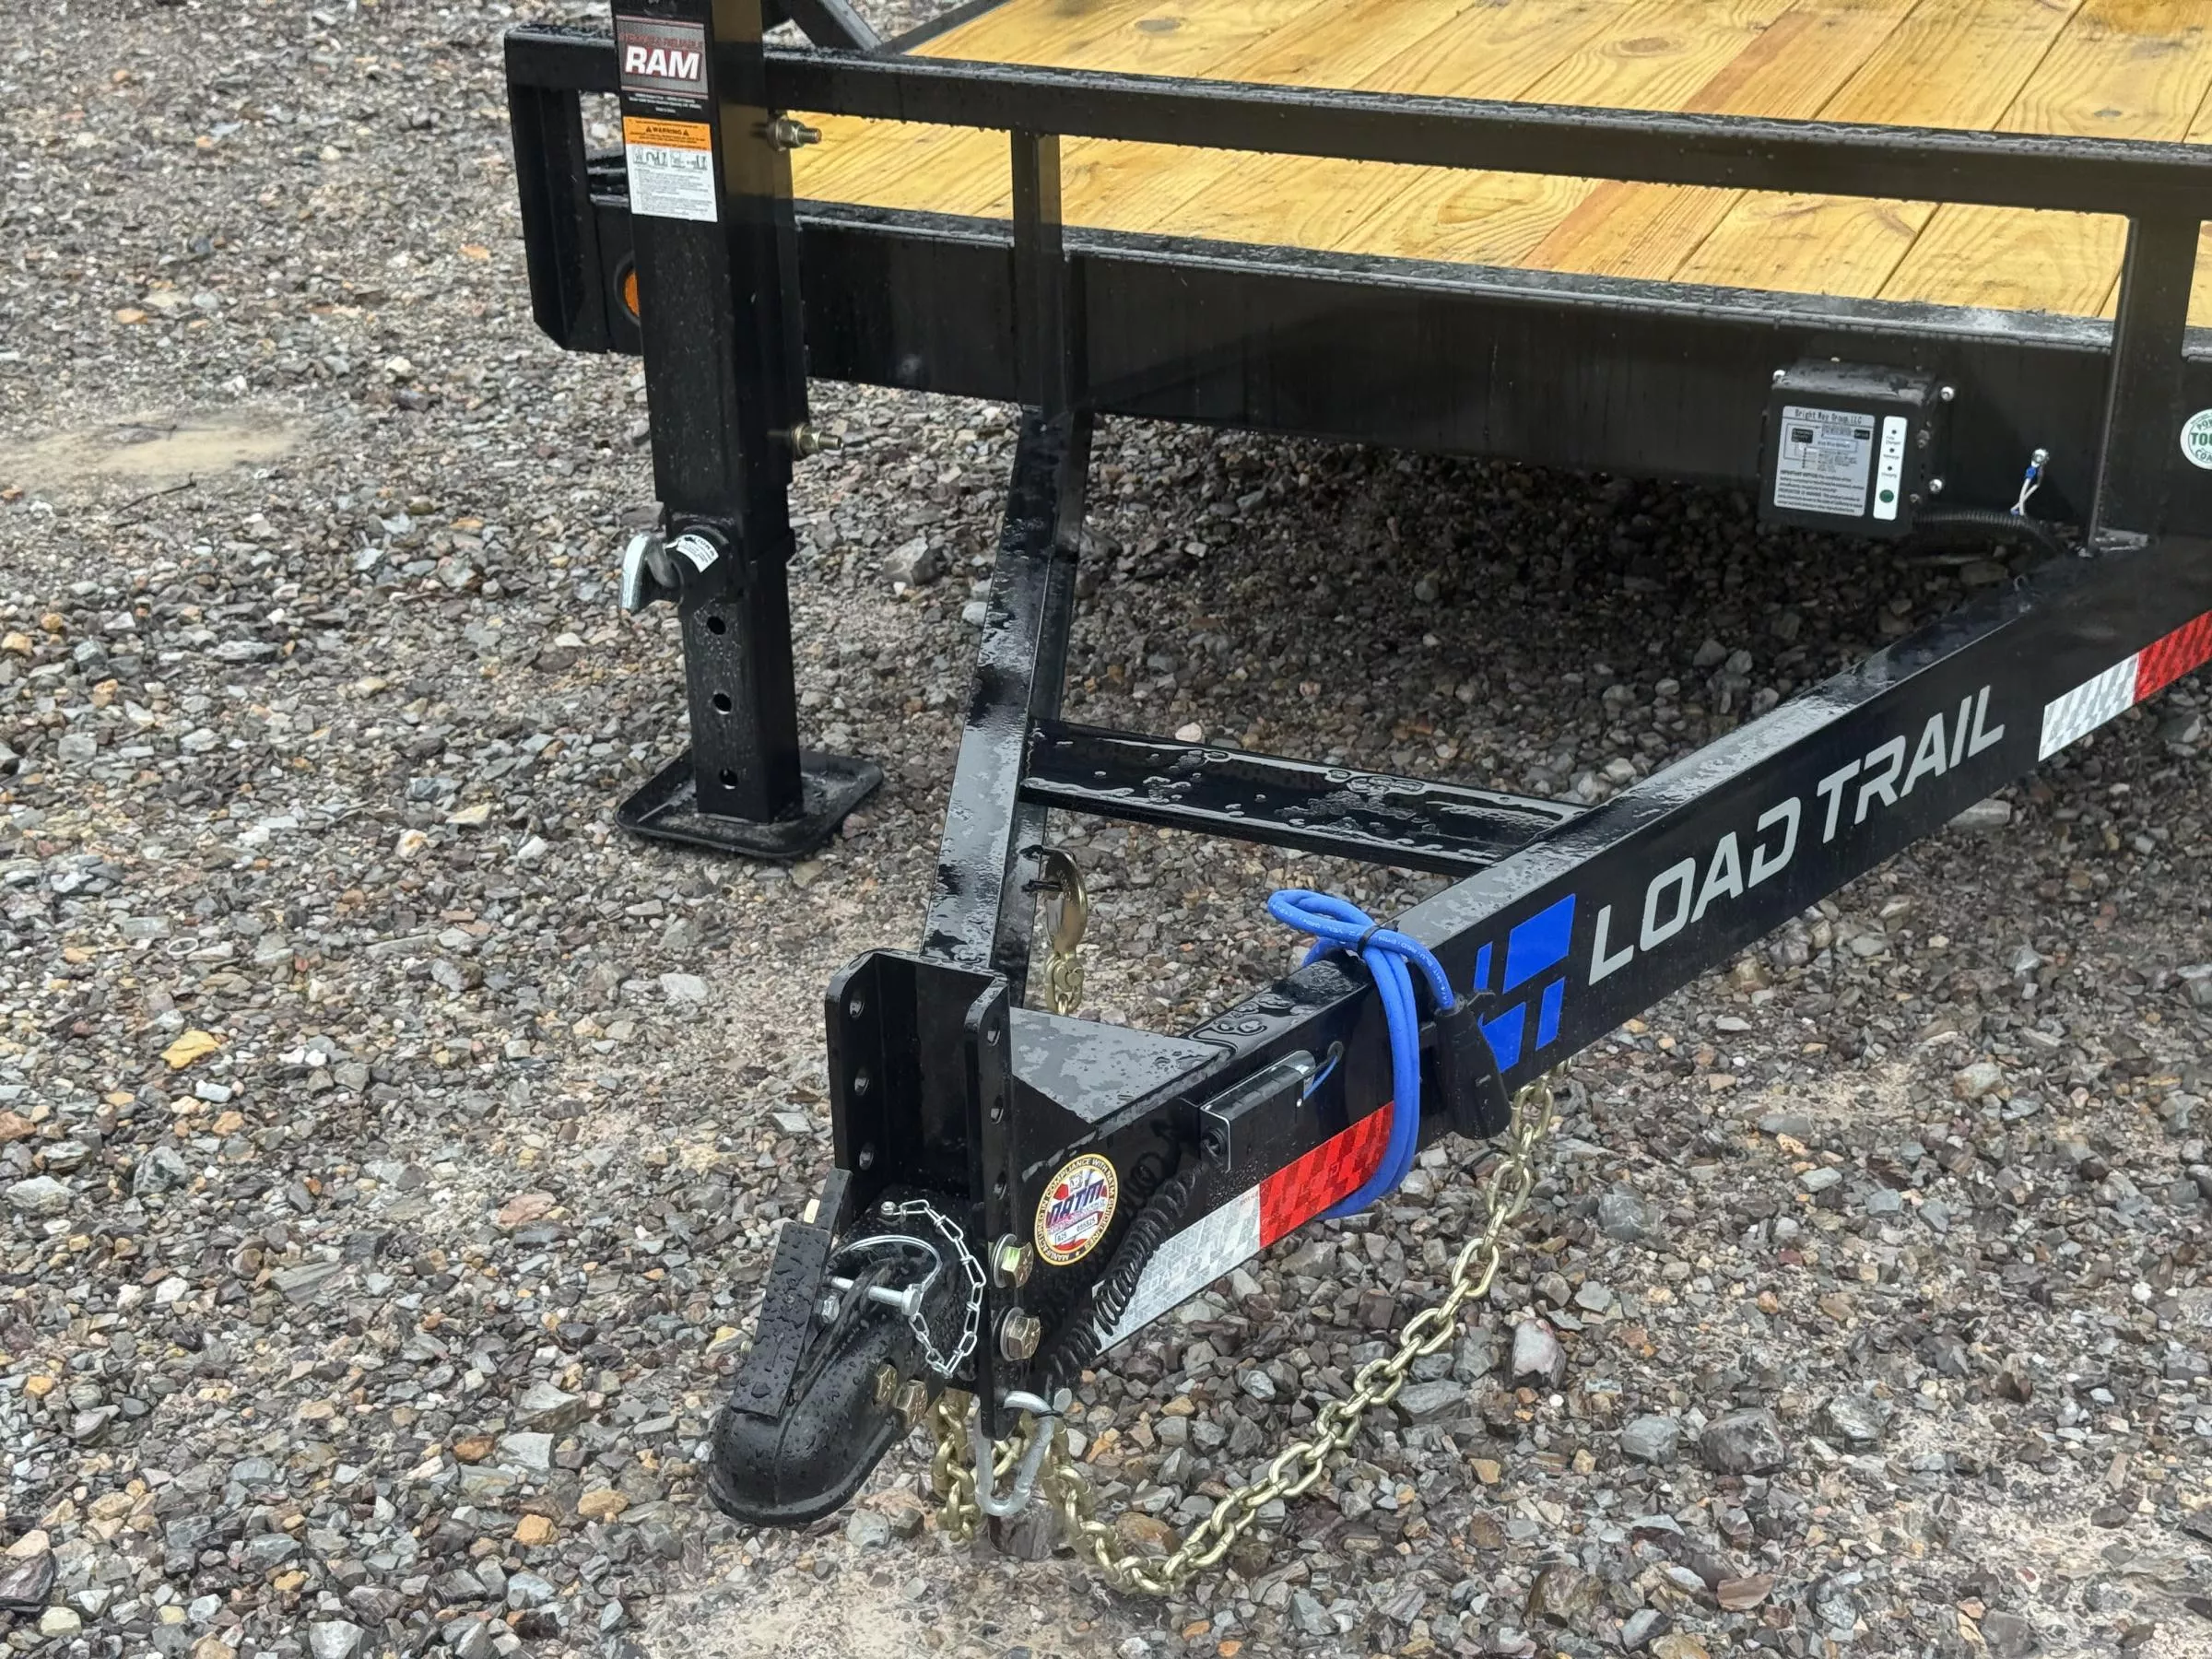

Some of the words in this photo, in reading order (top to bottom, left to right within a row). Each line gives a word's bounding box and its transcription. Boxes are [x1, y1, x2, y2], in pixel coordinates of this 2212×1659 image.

[625, 45, 700, 80] RAM
[1794, 408, 1816, 421] Bright
[1588, 796, 1801, 986] LOAD
[1817, 685, 2005, 843] TRAIL
[1047, 1158, 1092, 1198] COMPLIANCE
[1092, 1158, 1107, 1173] WITH
